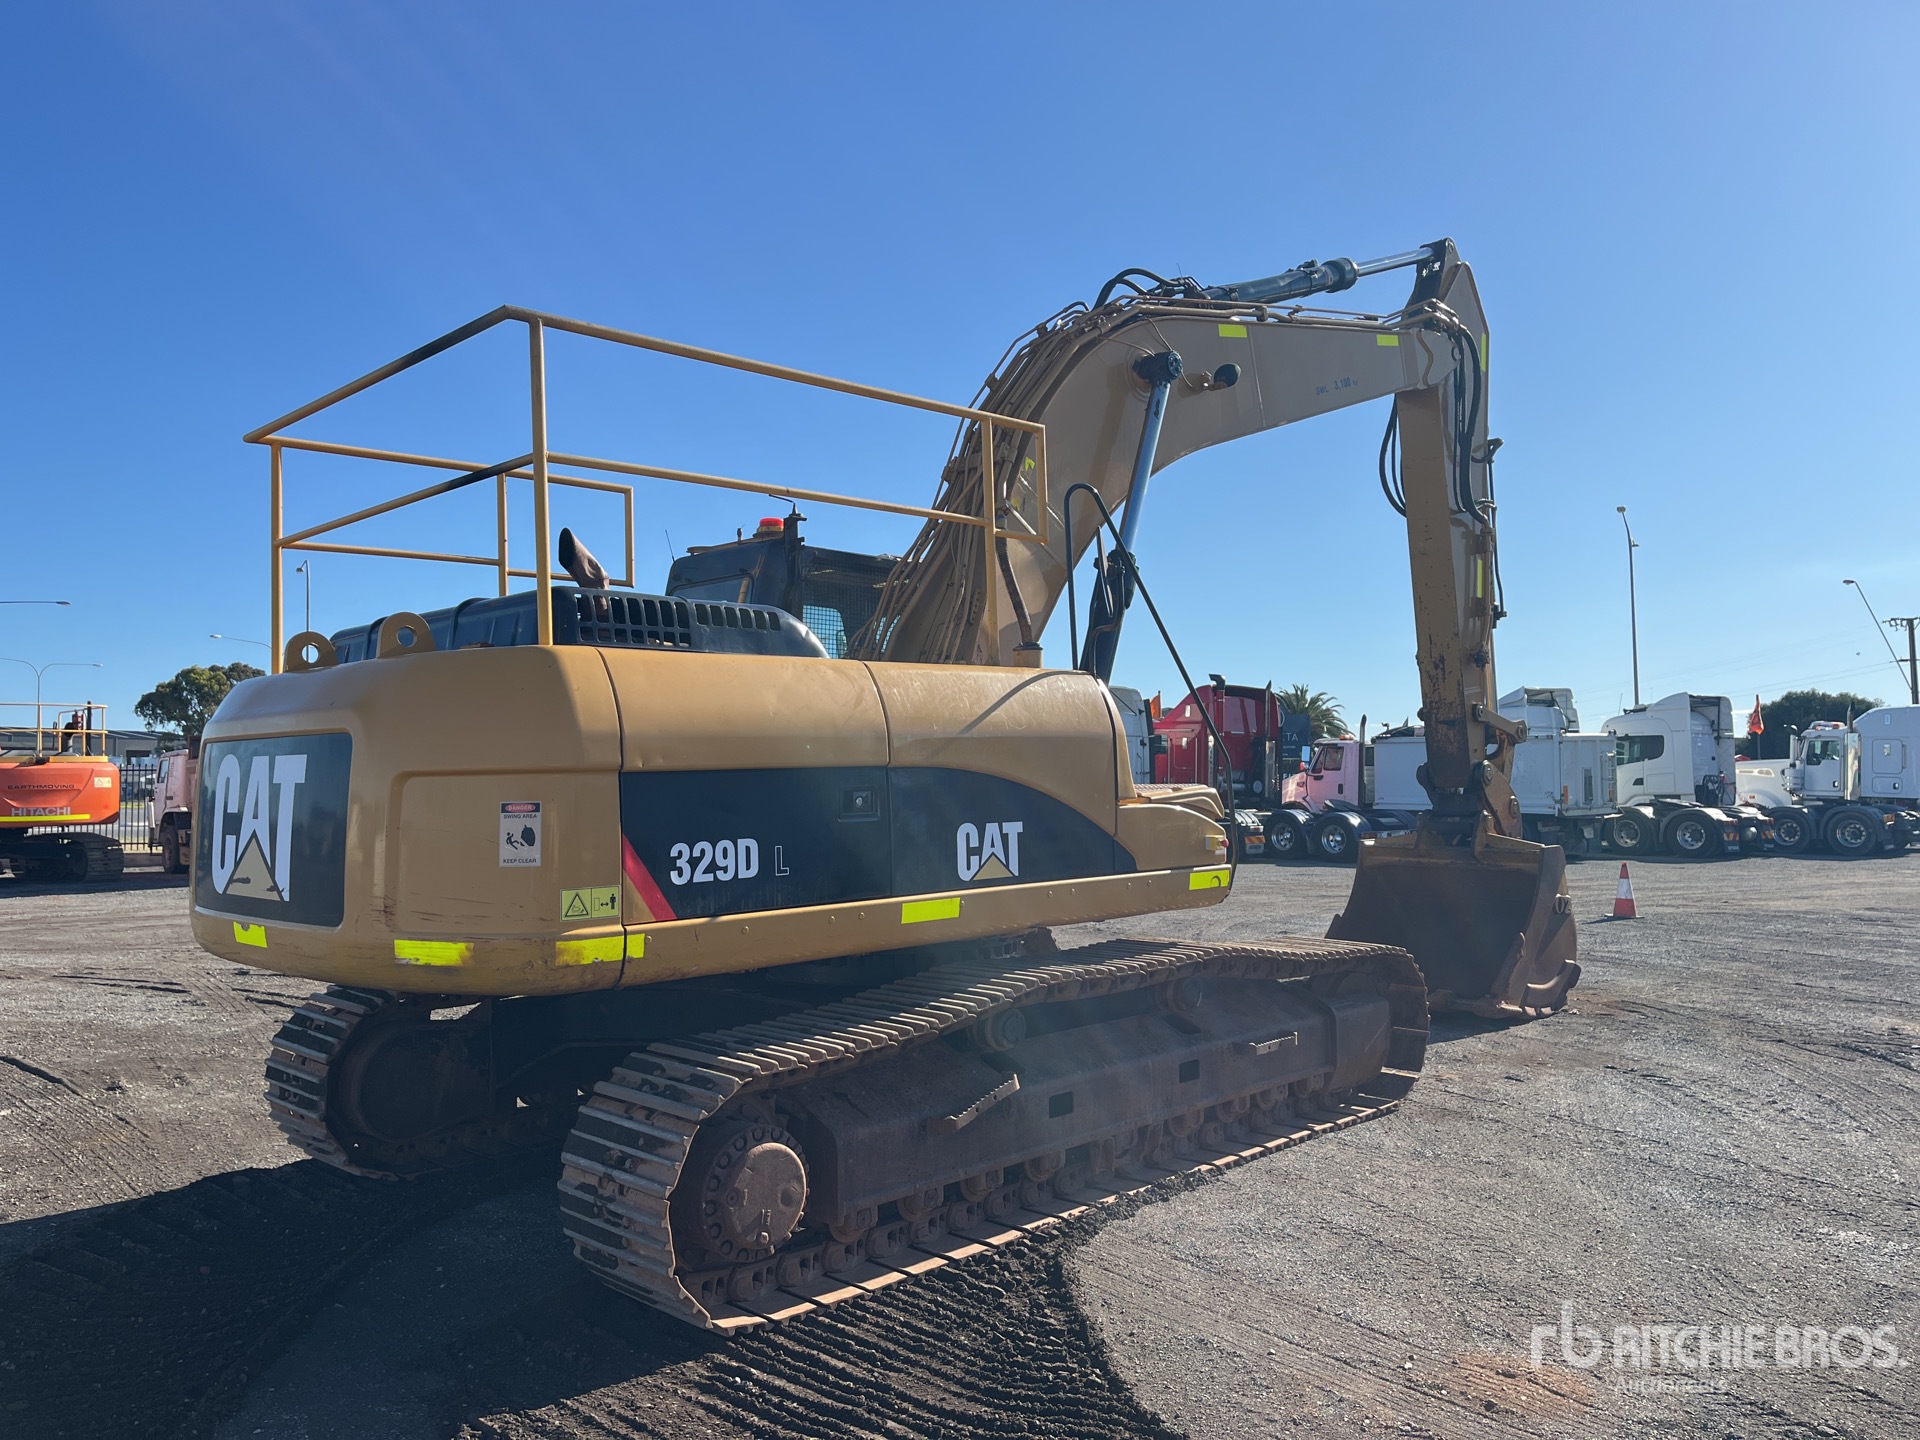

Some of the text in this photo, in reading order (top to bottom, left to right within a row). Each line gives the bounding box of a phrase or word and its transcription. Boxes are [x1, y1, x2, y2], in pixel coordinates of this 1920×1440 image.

[11, 806, 71, 817] HITACHI
[211, 753, 307, 902] CAT
[670, 838, 790, 885] 329D L
[956, 821, 1024, 882] CAT
